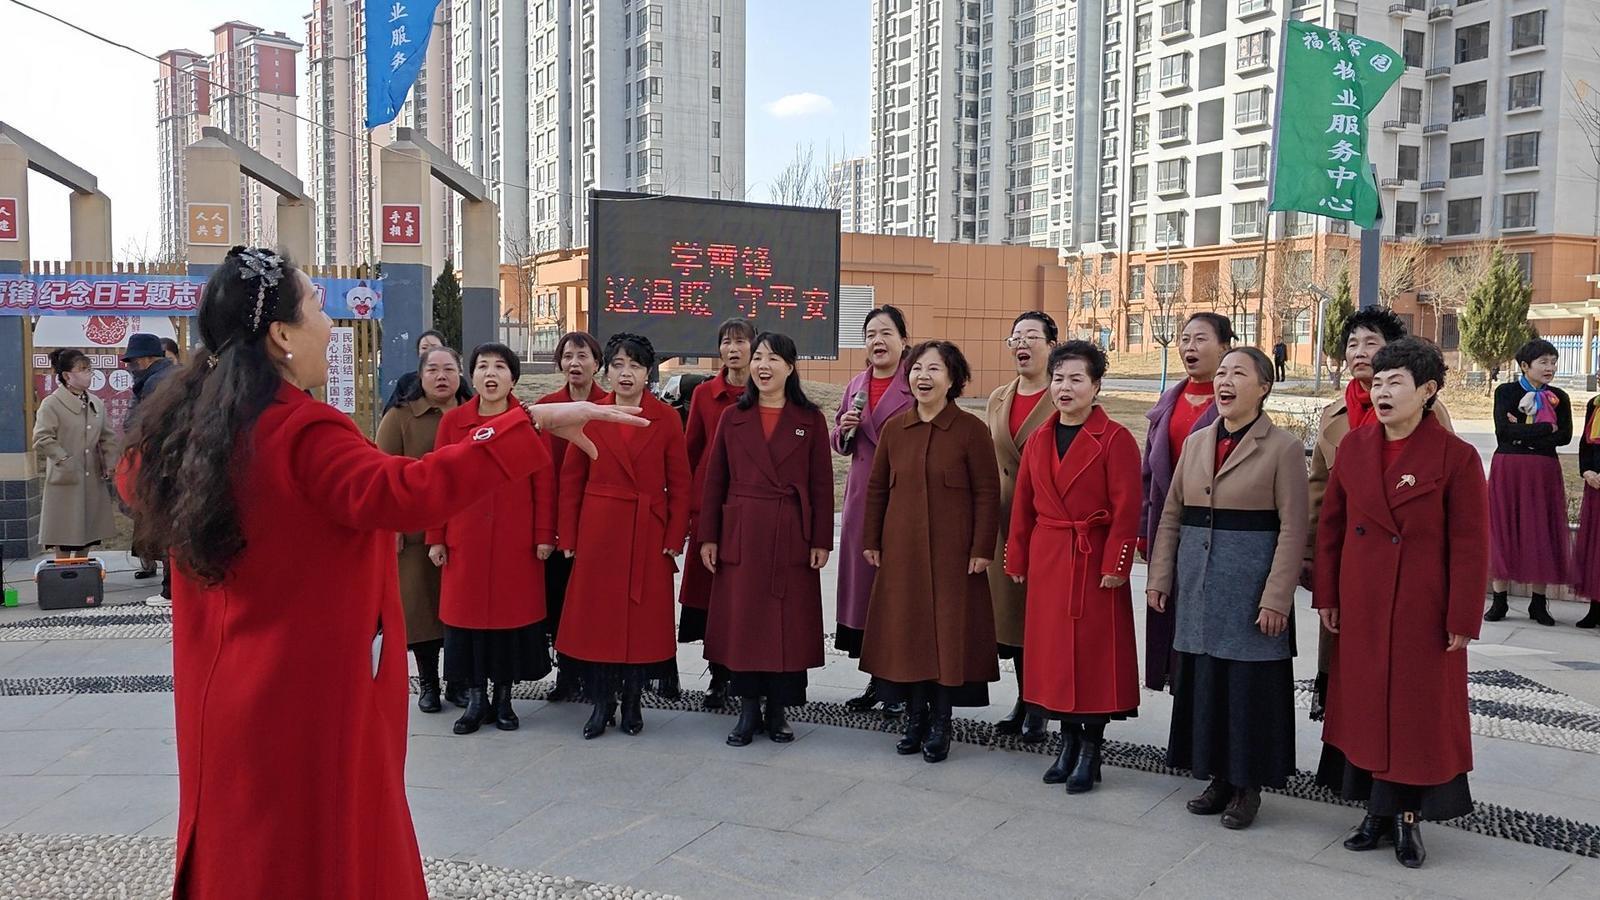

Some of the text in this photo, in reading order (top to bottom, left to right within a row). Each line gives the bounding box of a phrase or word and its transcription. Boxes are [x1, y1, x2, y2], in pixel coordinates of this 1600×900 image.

[1319, 60, 1361, 212] 物业服务中心
[195, 211, 225, 222] 人人
[604, 275, 830, 321] 送温暖 守平安
[342, 332, 354, 408] 民族团结一家亲
